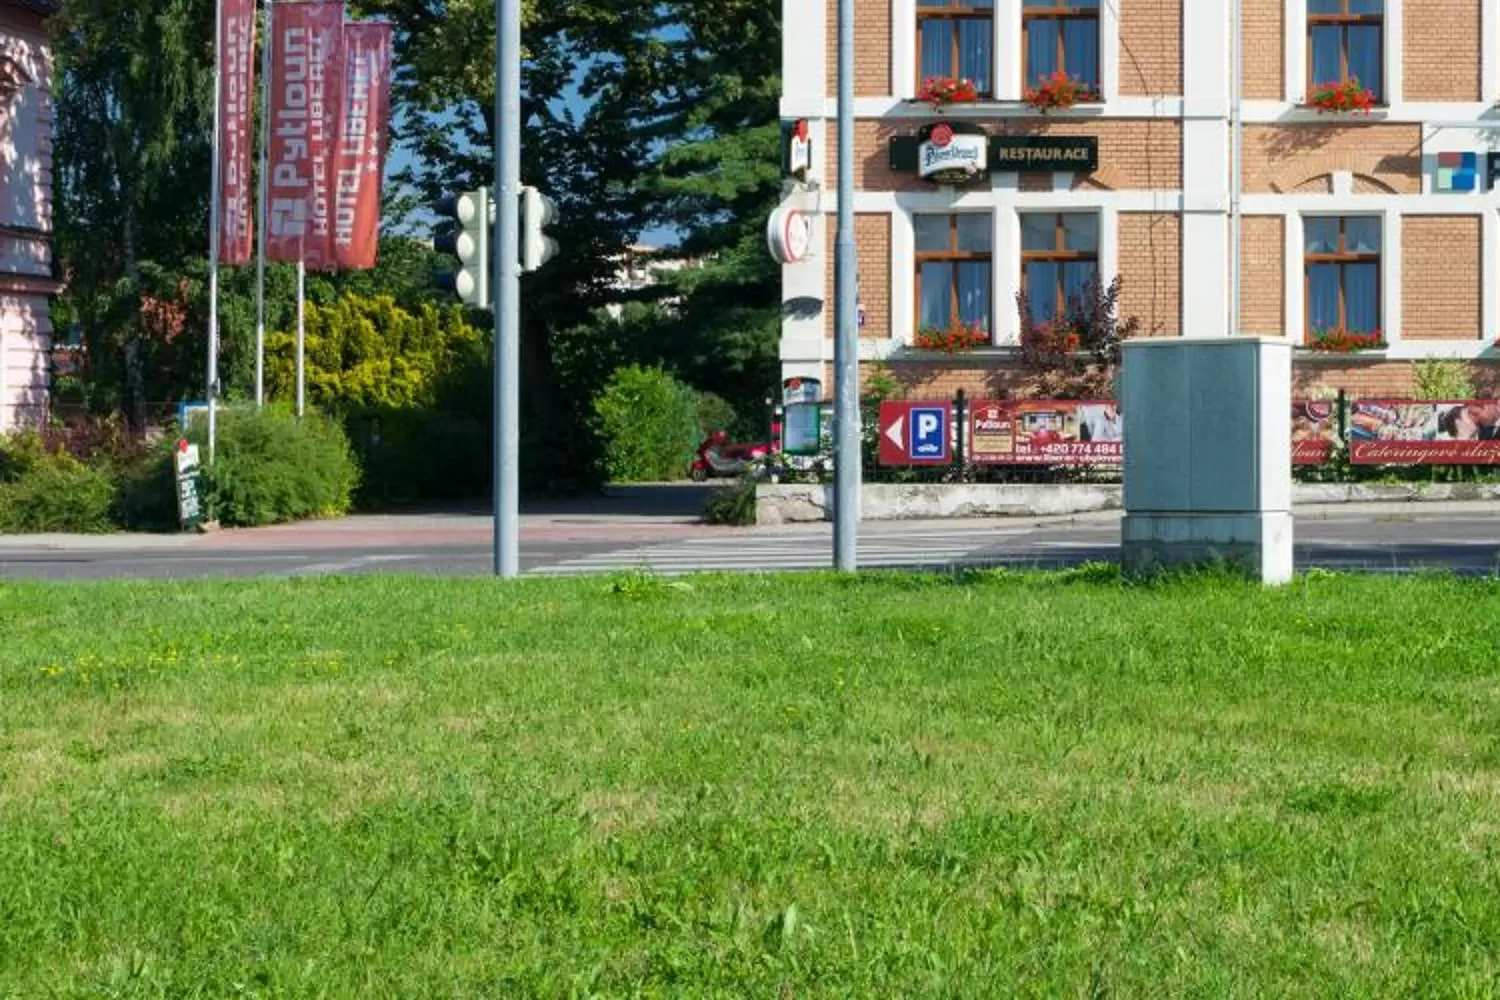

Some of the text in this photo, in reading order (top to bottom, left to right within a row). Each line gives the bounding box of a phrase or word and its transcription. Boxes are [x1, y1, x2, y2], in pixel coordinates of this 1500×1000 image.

[274, 27, 309, 187] Pytloun
[1000, 147, 1089, 160] RESTAURACE
[312, 155, 328, 236] HOTEL
[335, 162, 363, 245] HOTEL
[918, 414, 938, 439] P
[1071, 444, 1092, 454] 774
[1095, 444, 1116, 454] 484
